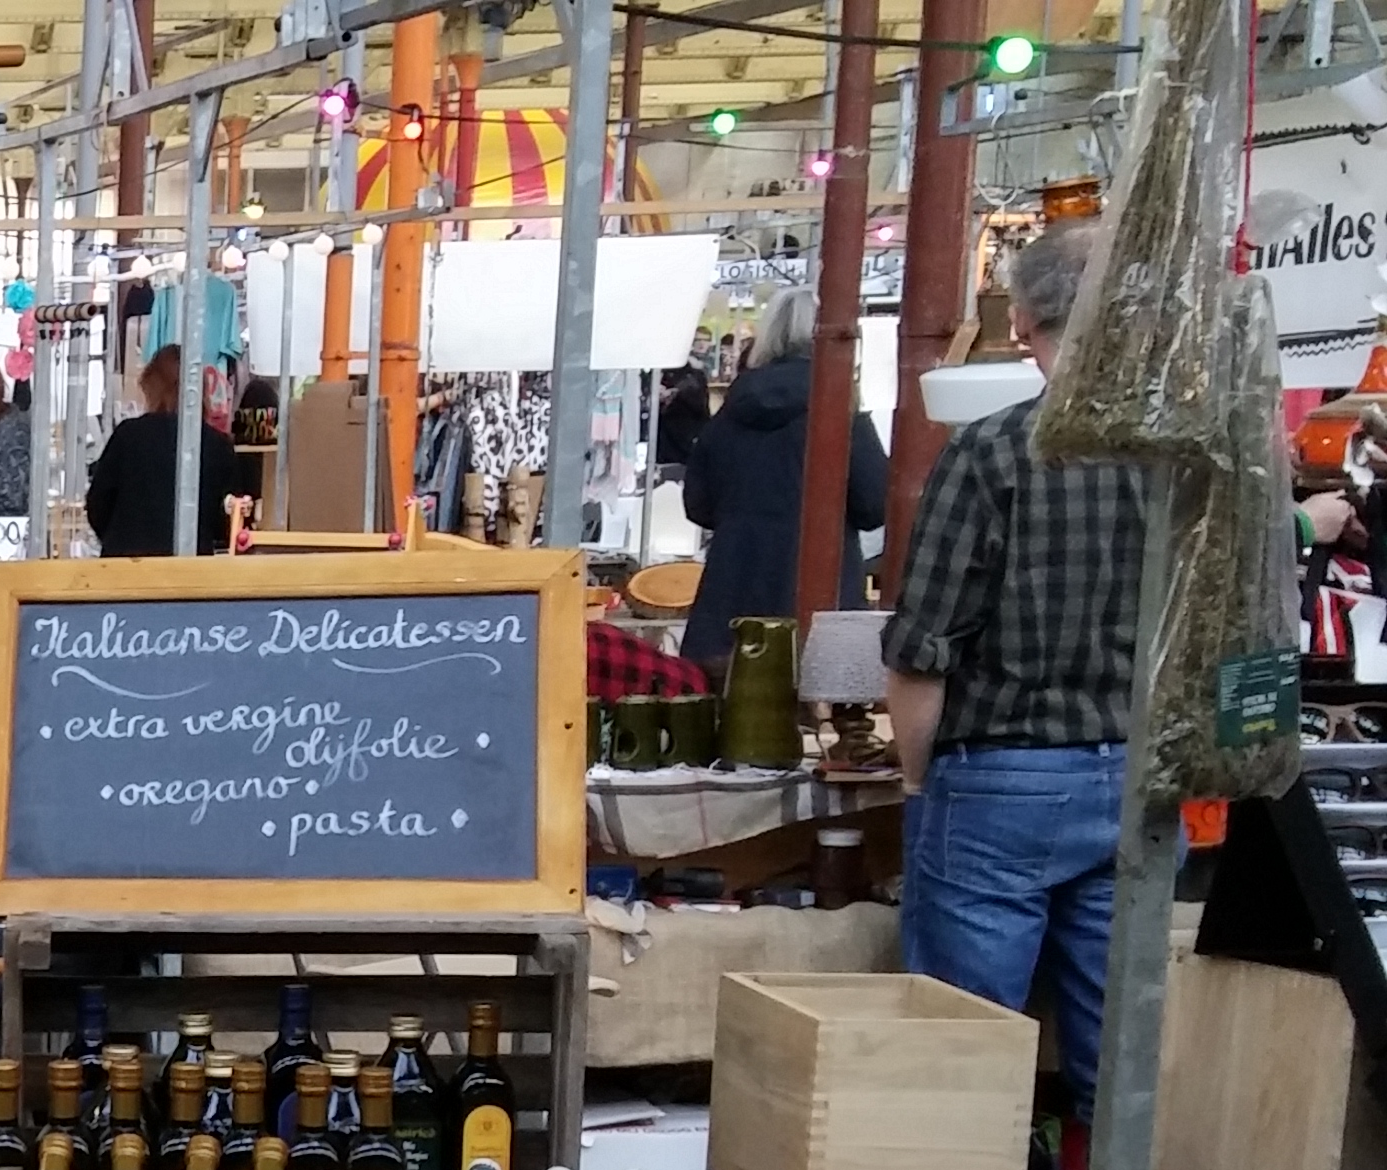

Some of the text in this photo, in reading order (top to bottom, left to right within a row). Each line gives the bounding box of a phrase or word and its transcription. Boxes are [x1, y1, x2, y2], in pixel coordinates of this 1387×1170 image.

[31, 607, 528, 660] Italiaanse Delicatessen
[64, 696, 352, 754] extra vergine
[284, 717, 459, 786] olijfolie
[118, 774, 301, 825] oregano
[288, 799, 438, 856] pasta
